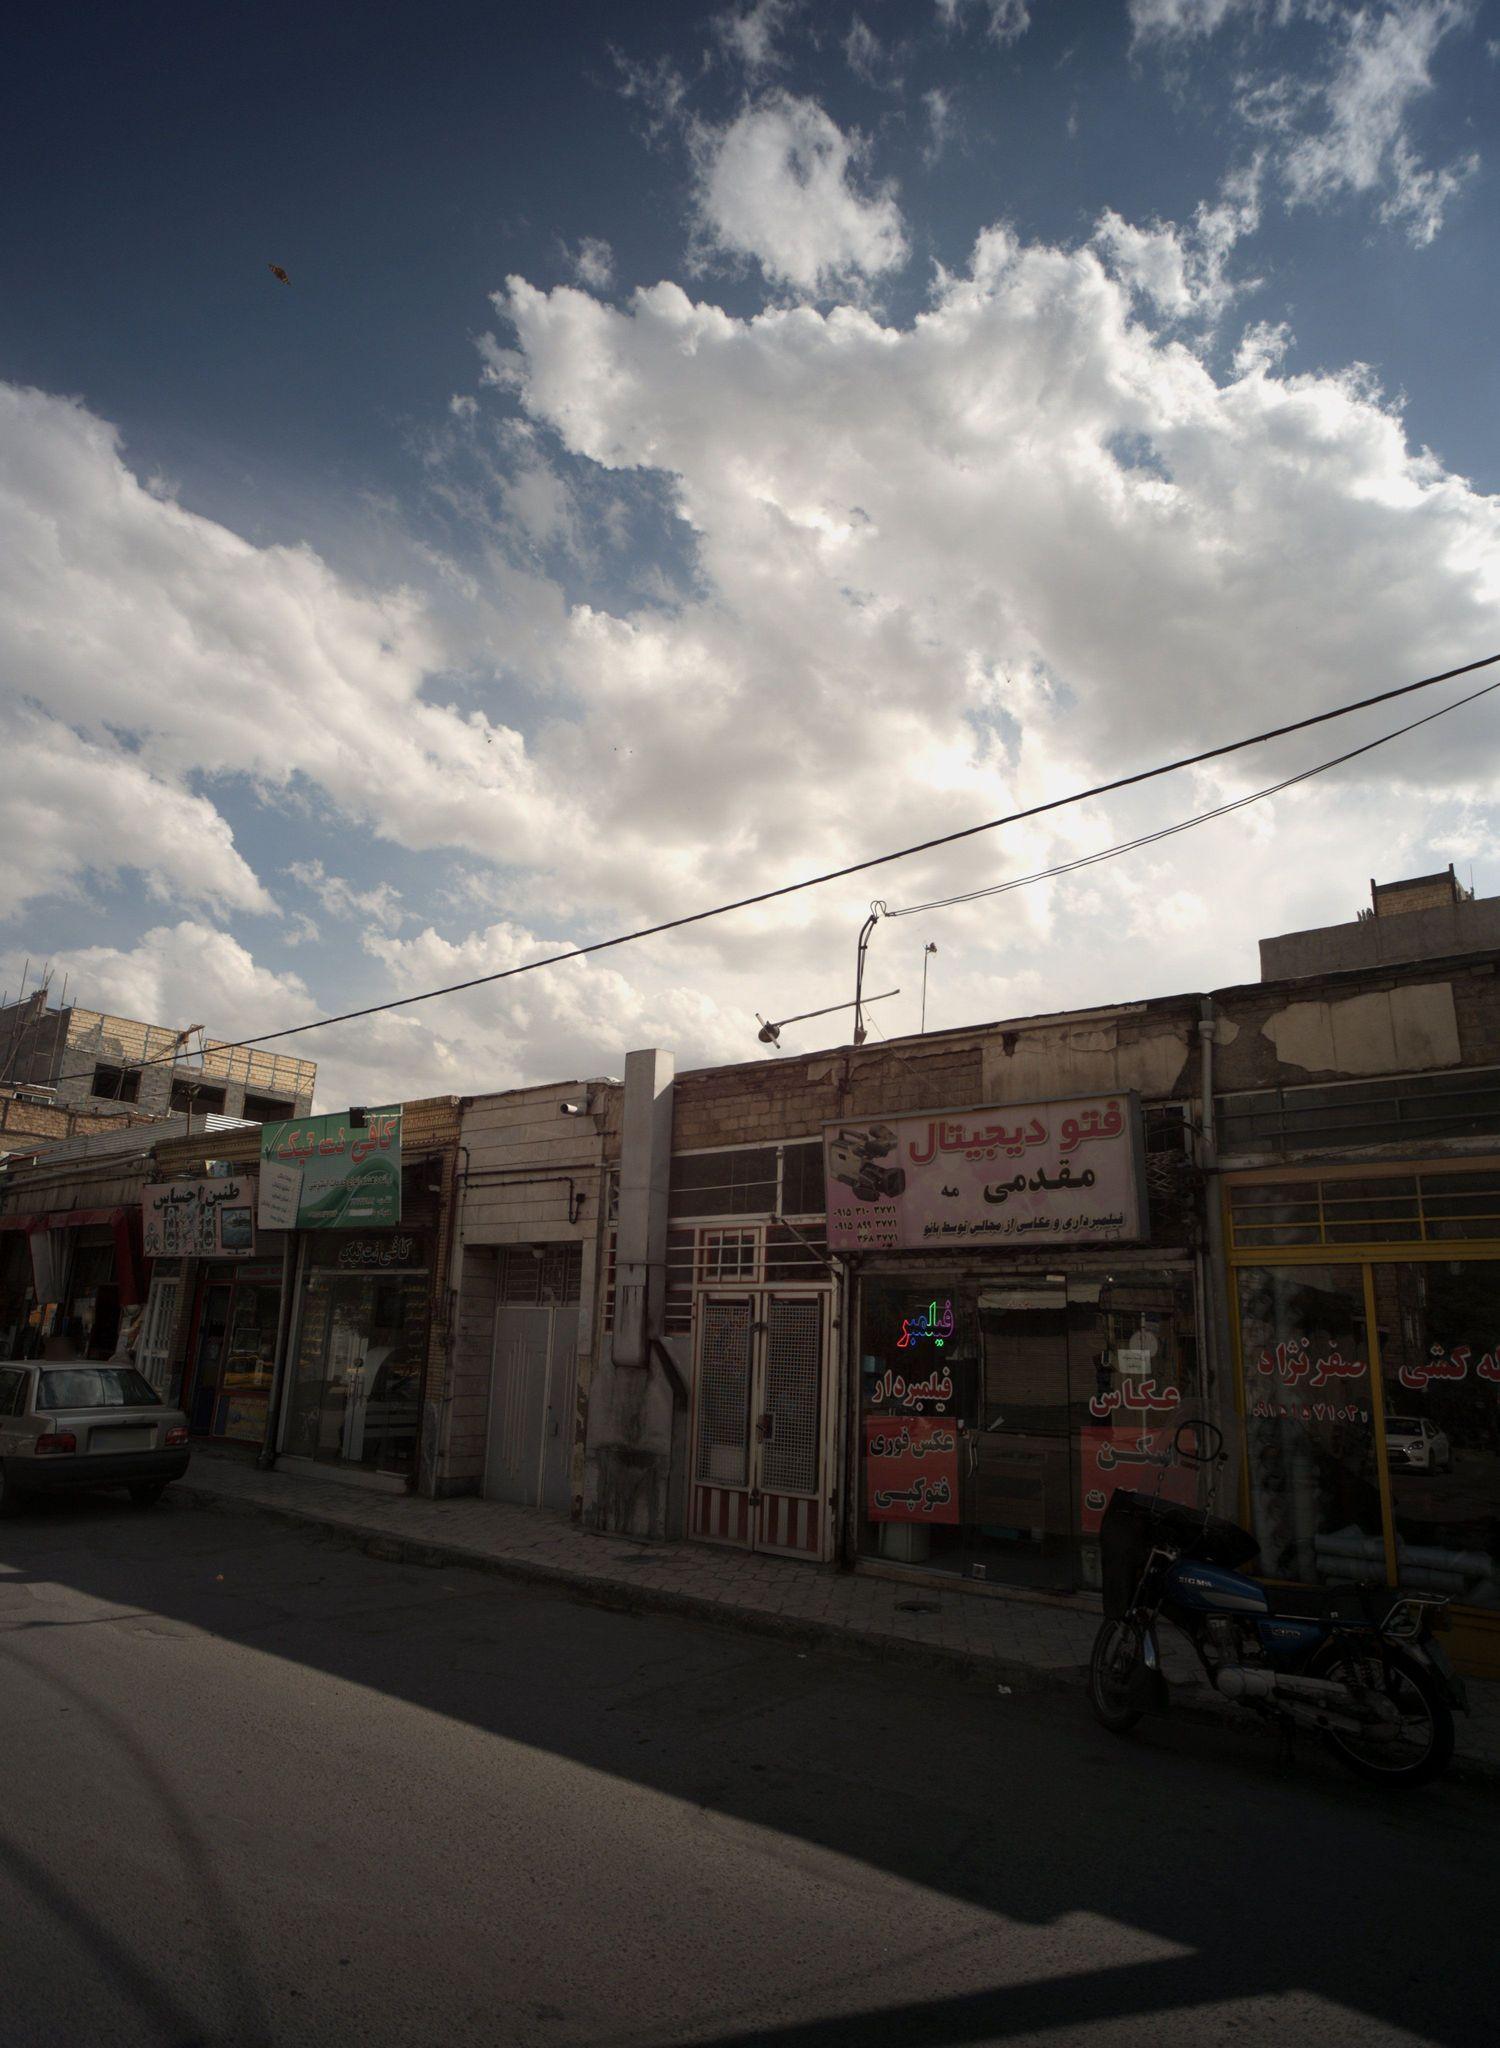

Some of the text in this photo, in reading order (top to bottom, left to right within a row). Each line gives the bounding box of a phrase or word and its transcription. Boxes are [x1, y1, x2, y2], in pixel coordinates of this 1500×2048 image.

[277, 1114, 398, 1166] کافی نت تیک
[908, 1100, 1125, 1164] فتو دیجیتال
[153, 1184, 206, 1210] احساس
[205, 1181, 240, 1207] طنین
[984, 1160, 1095, 1204] مقدمی
[1004, 1218, 1015, 1233] از
[1016, 1216, 1050, 1232] عکاسی
[1053, 1220, 1060, 1231] و
[1399, 1343, 1471, 1389] کشی
[872, 1366, 953, 1412] فیلمبردار
[1089, 1378, 1181, 1418] عکاس
[869, 1427, 955, 1459] عکس فوری
